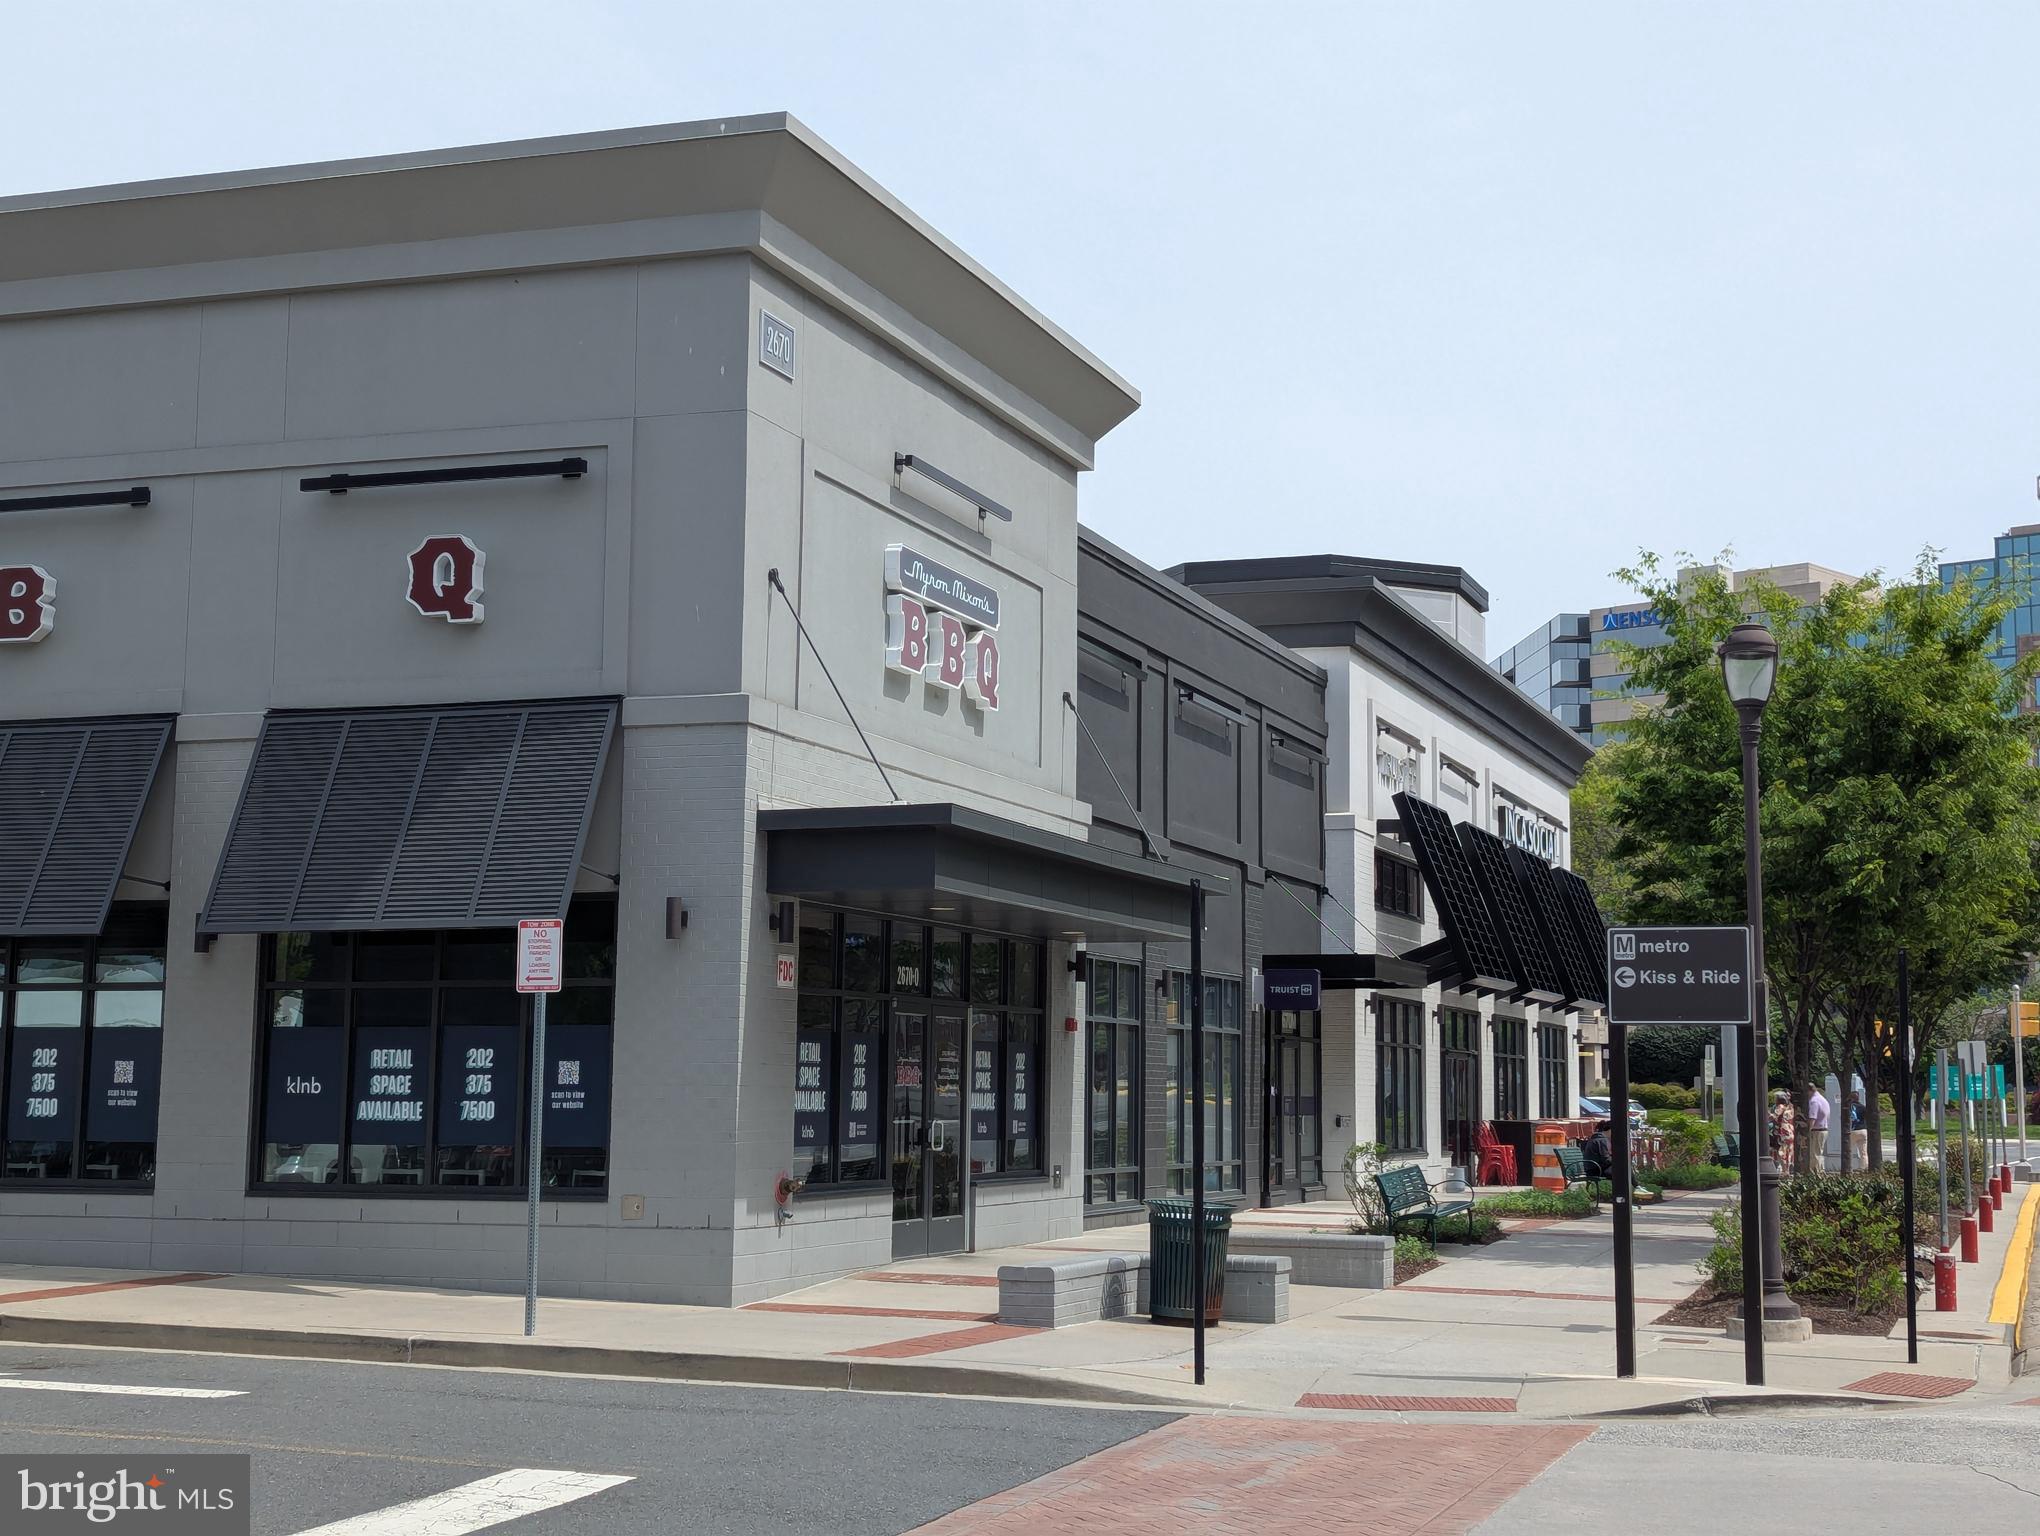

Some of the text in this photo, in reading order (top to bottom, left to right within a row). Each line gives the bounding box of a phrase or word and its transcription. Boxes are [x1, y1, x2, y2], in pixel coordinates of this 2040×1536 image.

[767, 326, 790, 363] 2670
[404, 533, 487, 625] Q
[904, 560, 995, 615] Myron Mixon's
[1618, 607, 1676, 629] ENSC
[886, 593, 1000, 712] BBQ
[1503, 806, 1528, 850] INCA
[533, 929, 548, 938] NO
[1639, 940, 1690, 953] metro
[778, 960, 794, 982] FDC
[1639, 969, 1741, 984] Kiss & Ride
[1270, 985, 1300, 994] TRUIST
[32, 1048, 58, 1068] 202
[370, 1048, 414, 1070] RETAIL
[466, 1048, 494, 1069] 202
[800, 1042, 821, 1063] RETAIL
[853, 1044, 866, 1064] 202
[31, 1072, 56, 1093] 375
[286, 1076, 322, 1094] klnb
[370, 1074, 412, 1096] SPACE
[465, 1074, 492, 1095] 375
[800, 1066, 820, 1087] SPACE
[853, 1068, 865, 1088] 375
[975, 1071, 991, 1090] SPACE
[551, 1091, 565, 1099] scan
[850, 1091, 867, 1111] 7500
[26, 1097, 58, 1118] 7500
[356, 1100, 424, 1122] AVAILABLE
[460, 1100, 495, 1121] 7500
